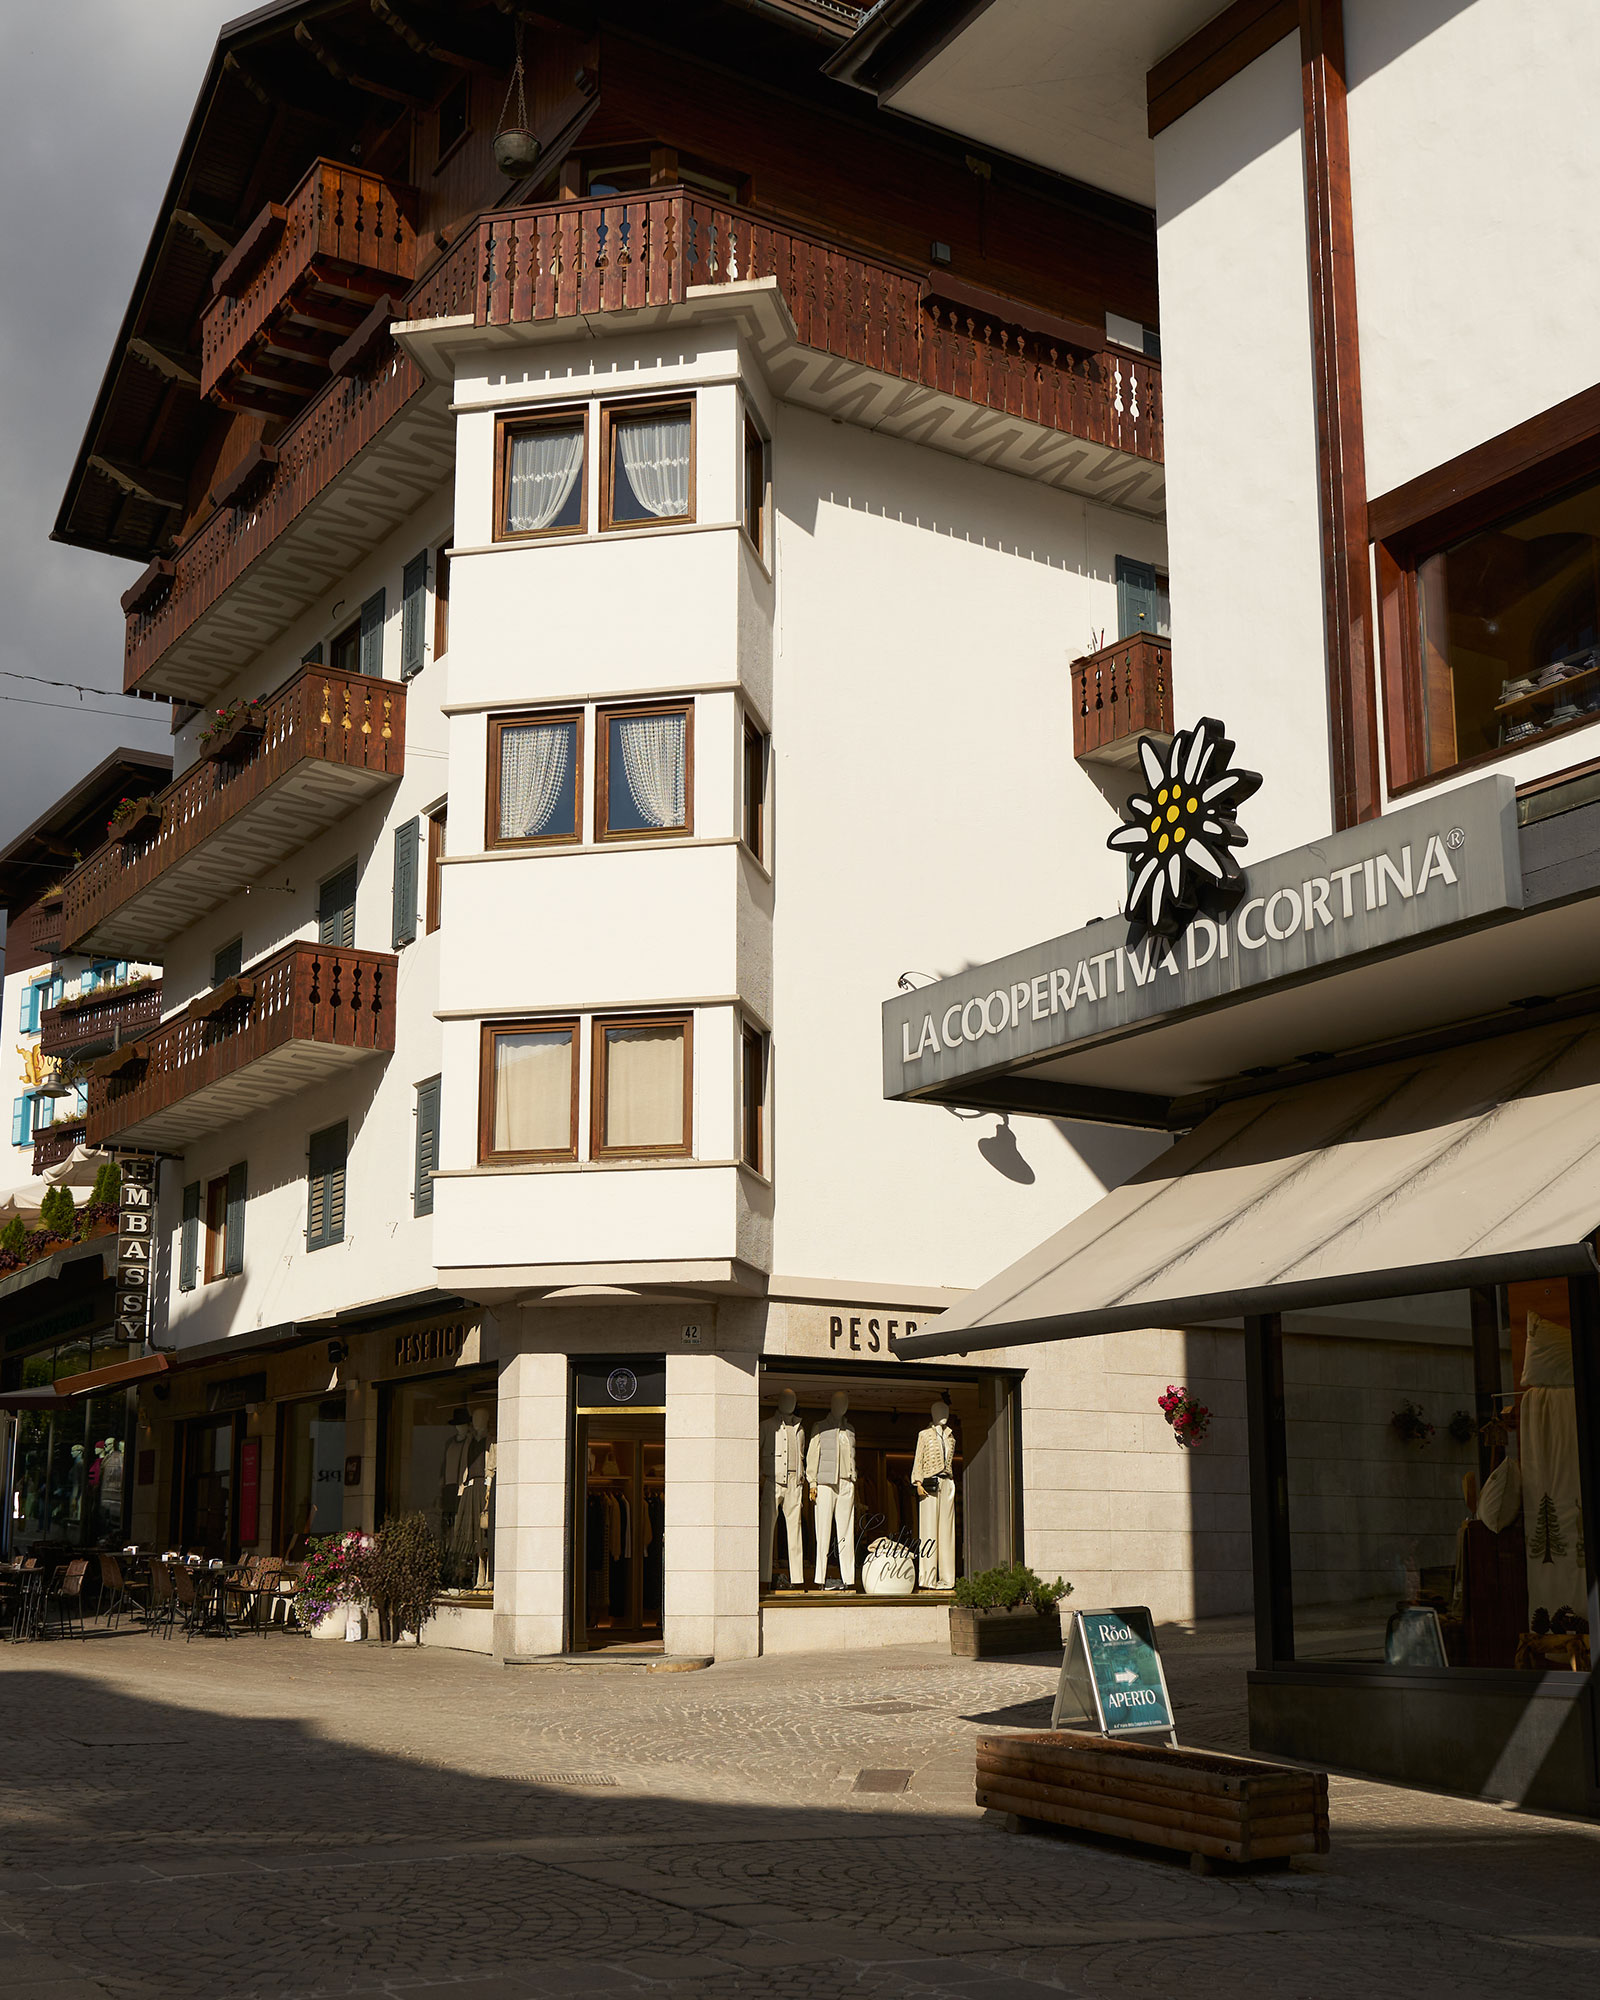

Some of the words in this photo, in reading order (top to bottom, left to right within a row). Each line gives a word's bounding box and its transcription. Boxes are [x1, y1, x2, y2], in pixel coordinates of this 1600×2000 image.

[902, 1014, 941, 1063] LA
[941, 935, 1179, 1049] COOPERATIVA
[1187, 910, 1229, 970] DI
[121, 1162, 151, 1340] EMBASSY
[395, 1323, 466, 1367] PESERICO
[685, 1326, 698, 1339] 42
[855, 1511, 937, 1567] Cortina
[1108, 1689, 1156, 1709] APERTO
